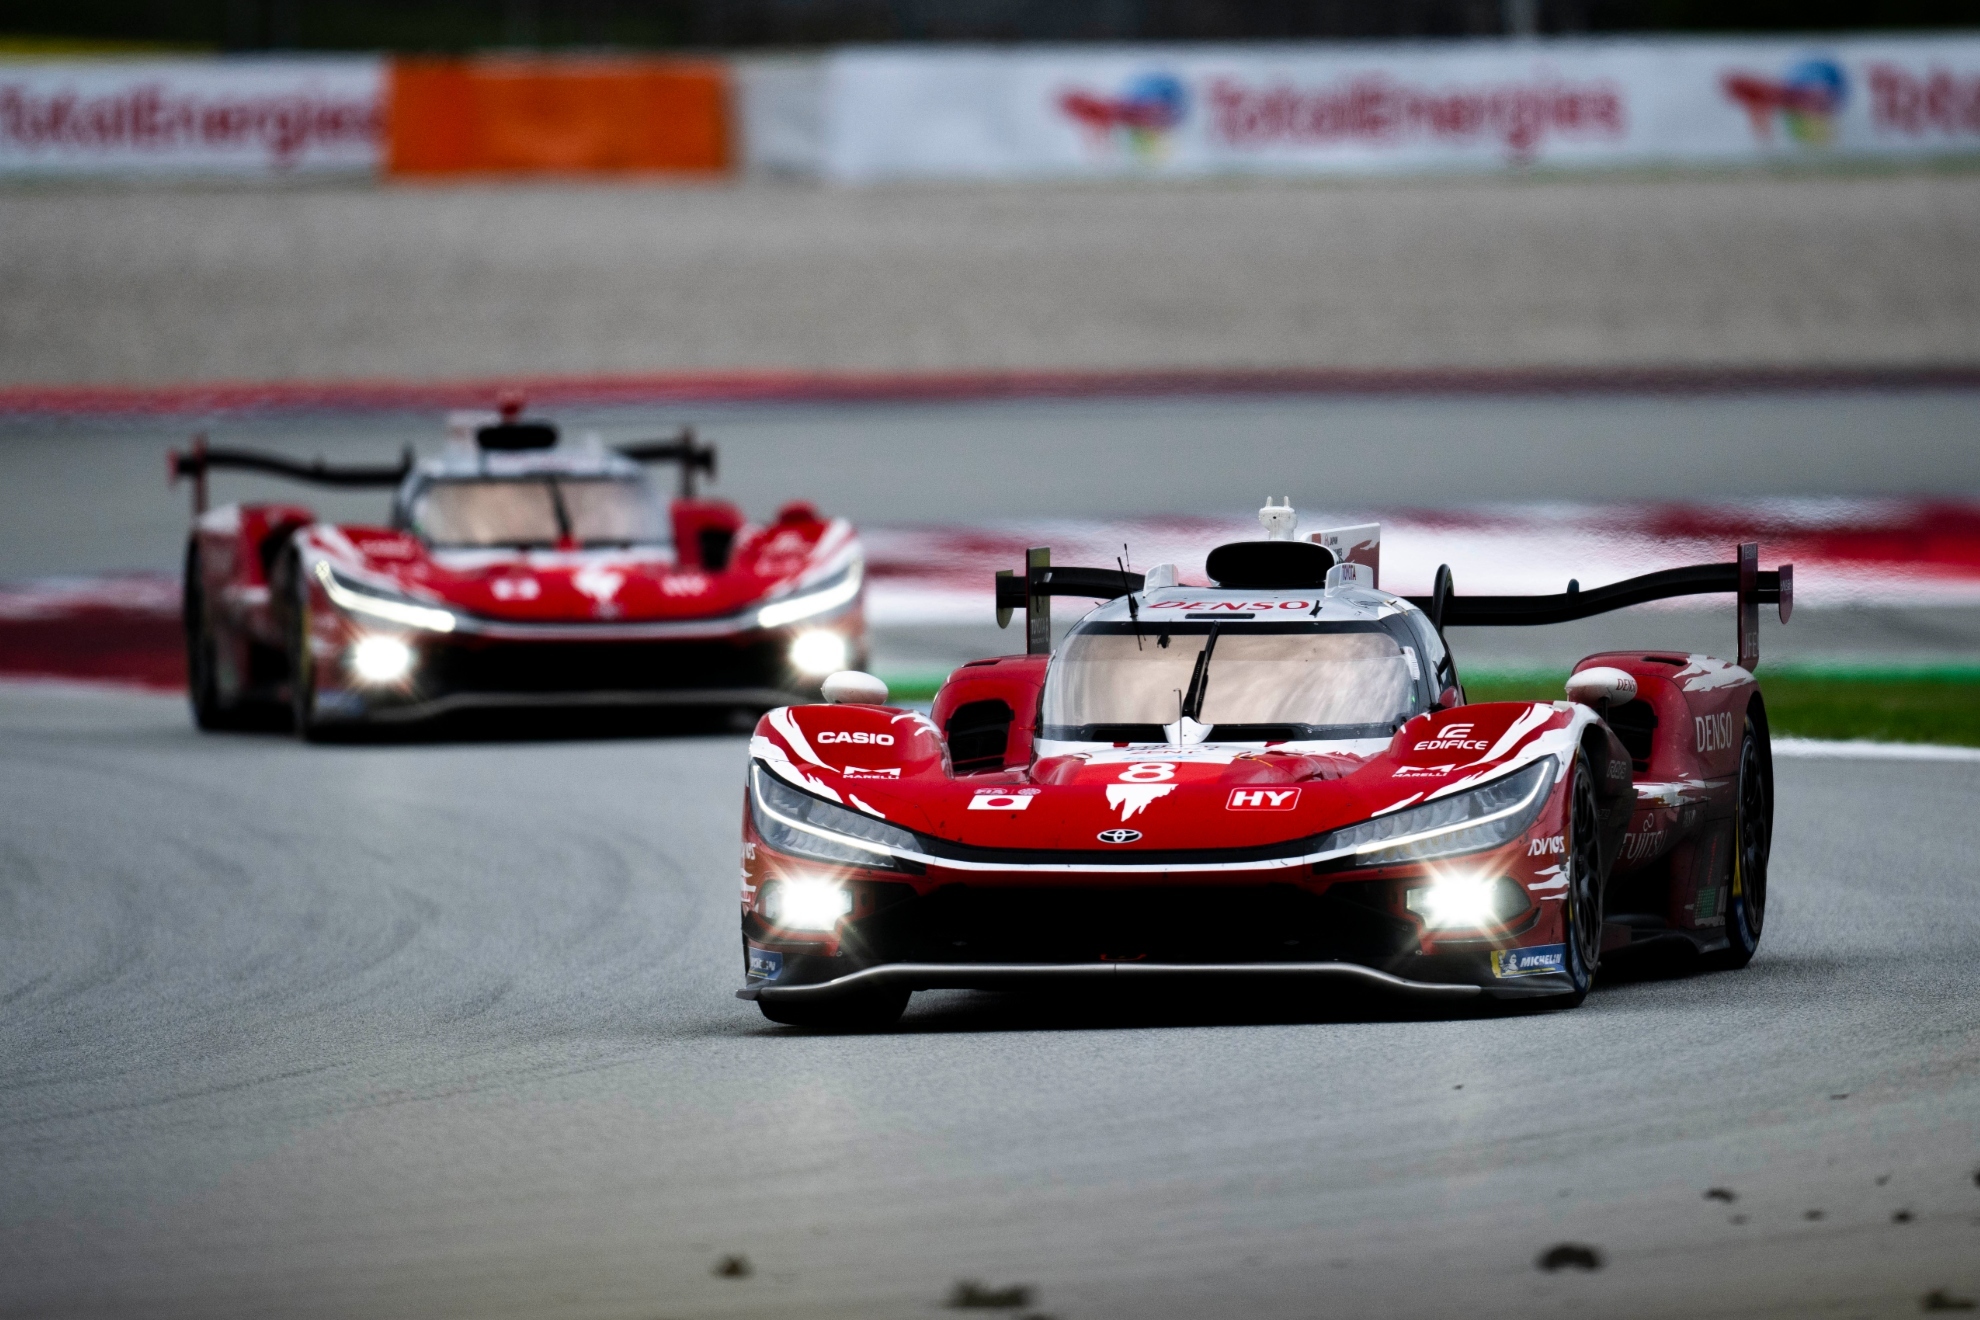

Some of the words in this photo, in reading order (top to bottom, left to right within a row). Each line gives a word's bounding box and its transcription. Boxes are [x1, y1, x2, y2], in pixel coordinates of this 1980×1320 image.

[1209, 76, 1624, 159] TotalEnergies
[1148, 600, 1310, 611] DENSO
[817, 731, 895, 746] CASIO
[1695, 711, 1733, 753] DENSO
[1413, 739, 1489, 751] EDIFICE
[1118, 762, 1176, 783] 8
[1231, 790, 1295, 807] HY
[1527, 835, 1565, 857] ADVICS
[1520, 953, 1562, 968] MICHELIN
